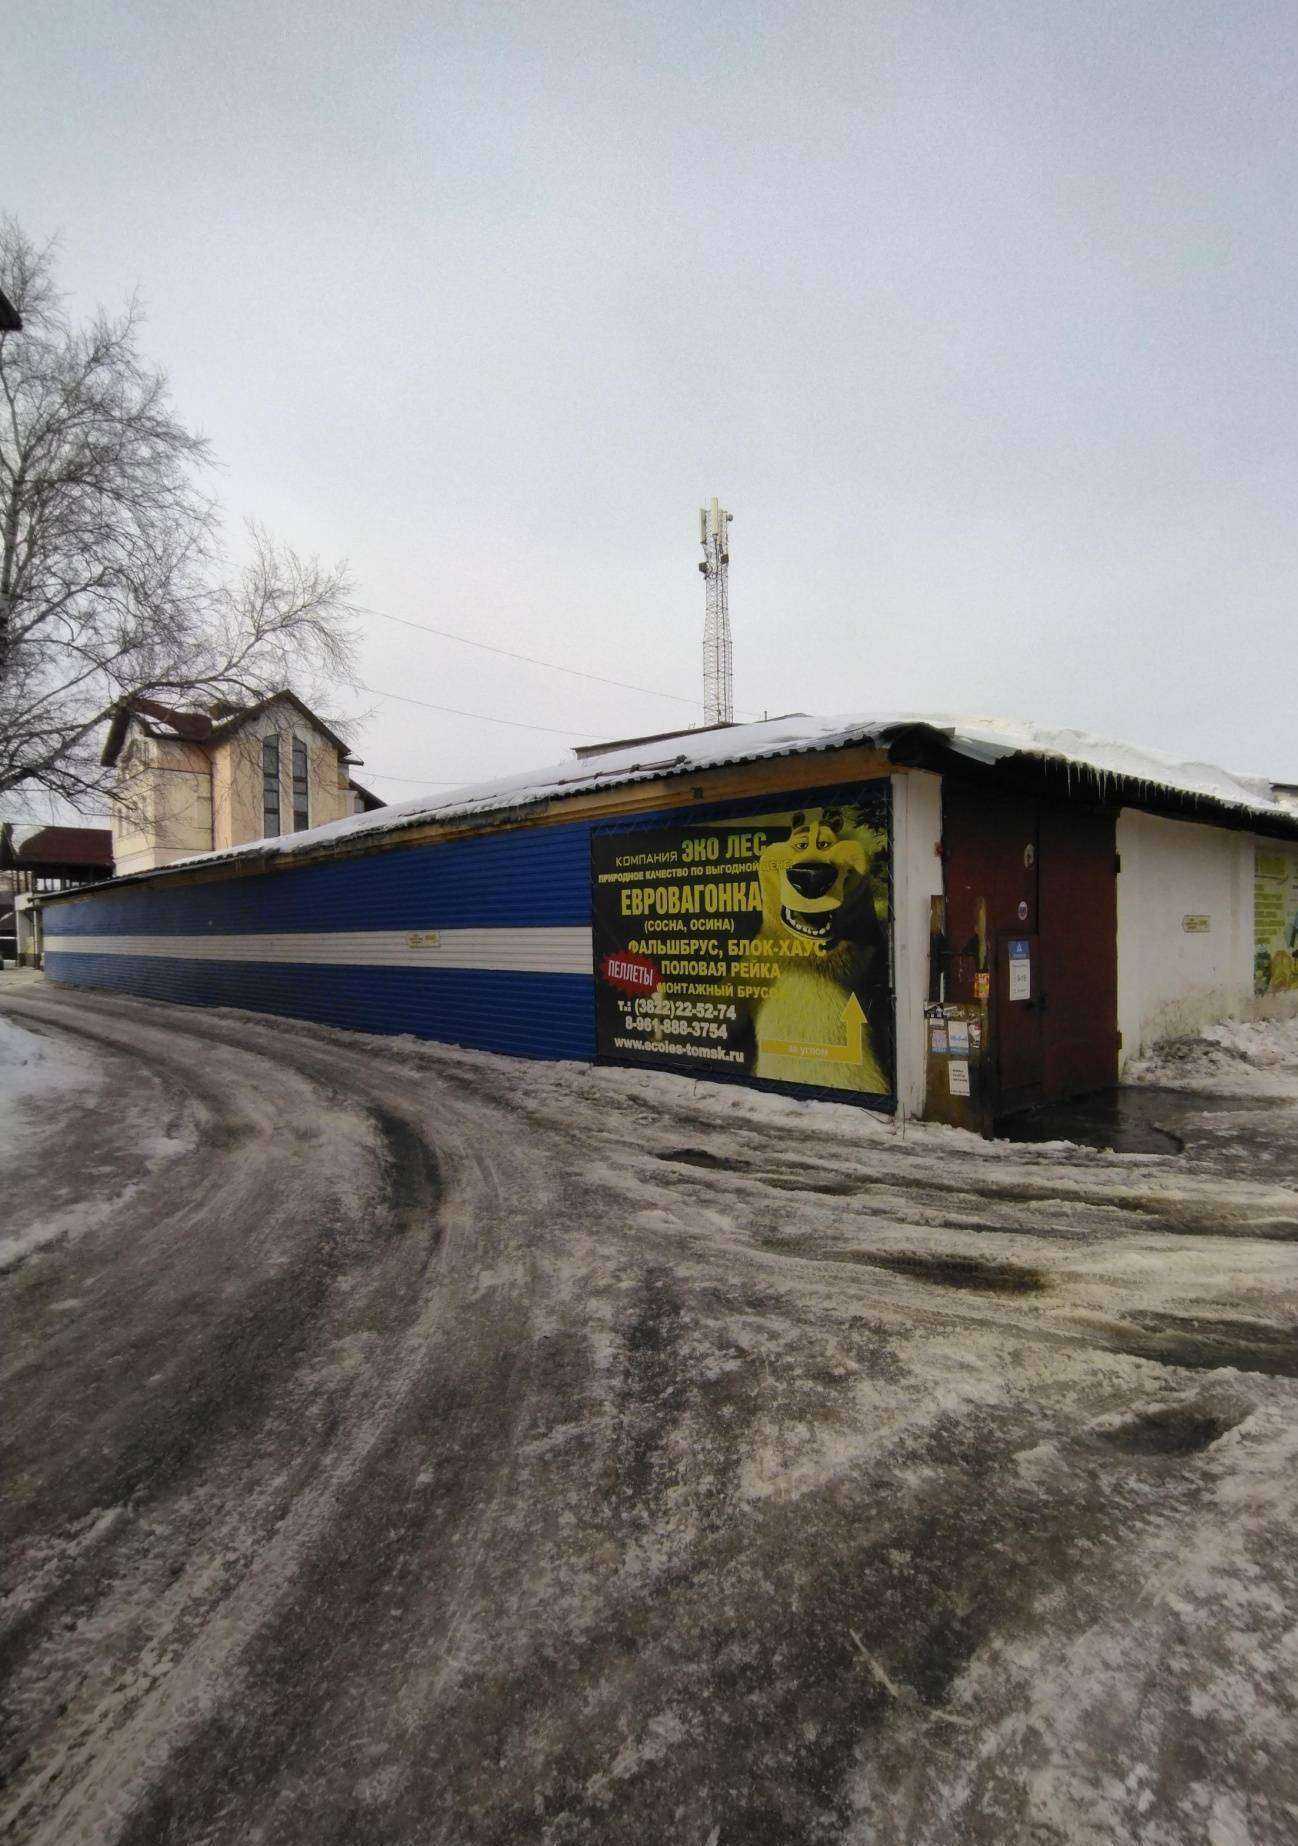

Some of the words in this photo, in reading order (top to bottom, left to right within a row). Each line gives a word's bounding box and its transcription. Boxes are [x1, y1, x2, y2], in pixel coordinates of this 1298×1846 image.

[615, 851, 678, 867] КОМПАНИЯ
[681, 837, 719, 862] ЭКО
[725, 832, 767, 859] ЛЕС
[598, 871, 644, 883] ПРИРОДНОЕ
[645, 868, 688, 879] КАЧЕСТВО
[690, 867, 704, 876] ПО
[705, 861, 760, 874] ВЫГОДНОЙ
[621, 881, 763, 916] ЕВРОВАГОНКА
[644, 920, 688, 934] (СОСНА,
[690, 919, 735, 932] ОСИНА)
[628, 939, 724, 958] ФАЛЬШБРУС,
[728, 939, 827, 957] БЛОК-ХАУС
[607, 959, 654, 986] ПЕЛЛЕТЫ
[661, 960, 727, 976] ПОЛОВАЯ
[730, 961, 781, 978] РЕЙКА
[657, 982, 734, 997] МОНТАЖНЫЙ
[613, 1037, 745, 1063] www.ecoles-tomsk.ru
